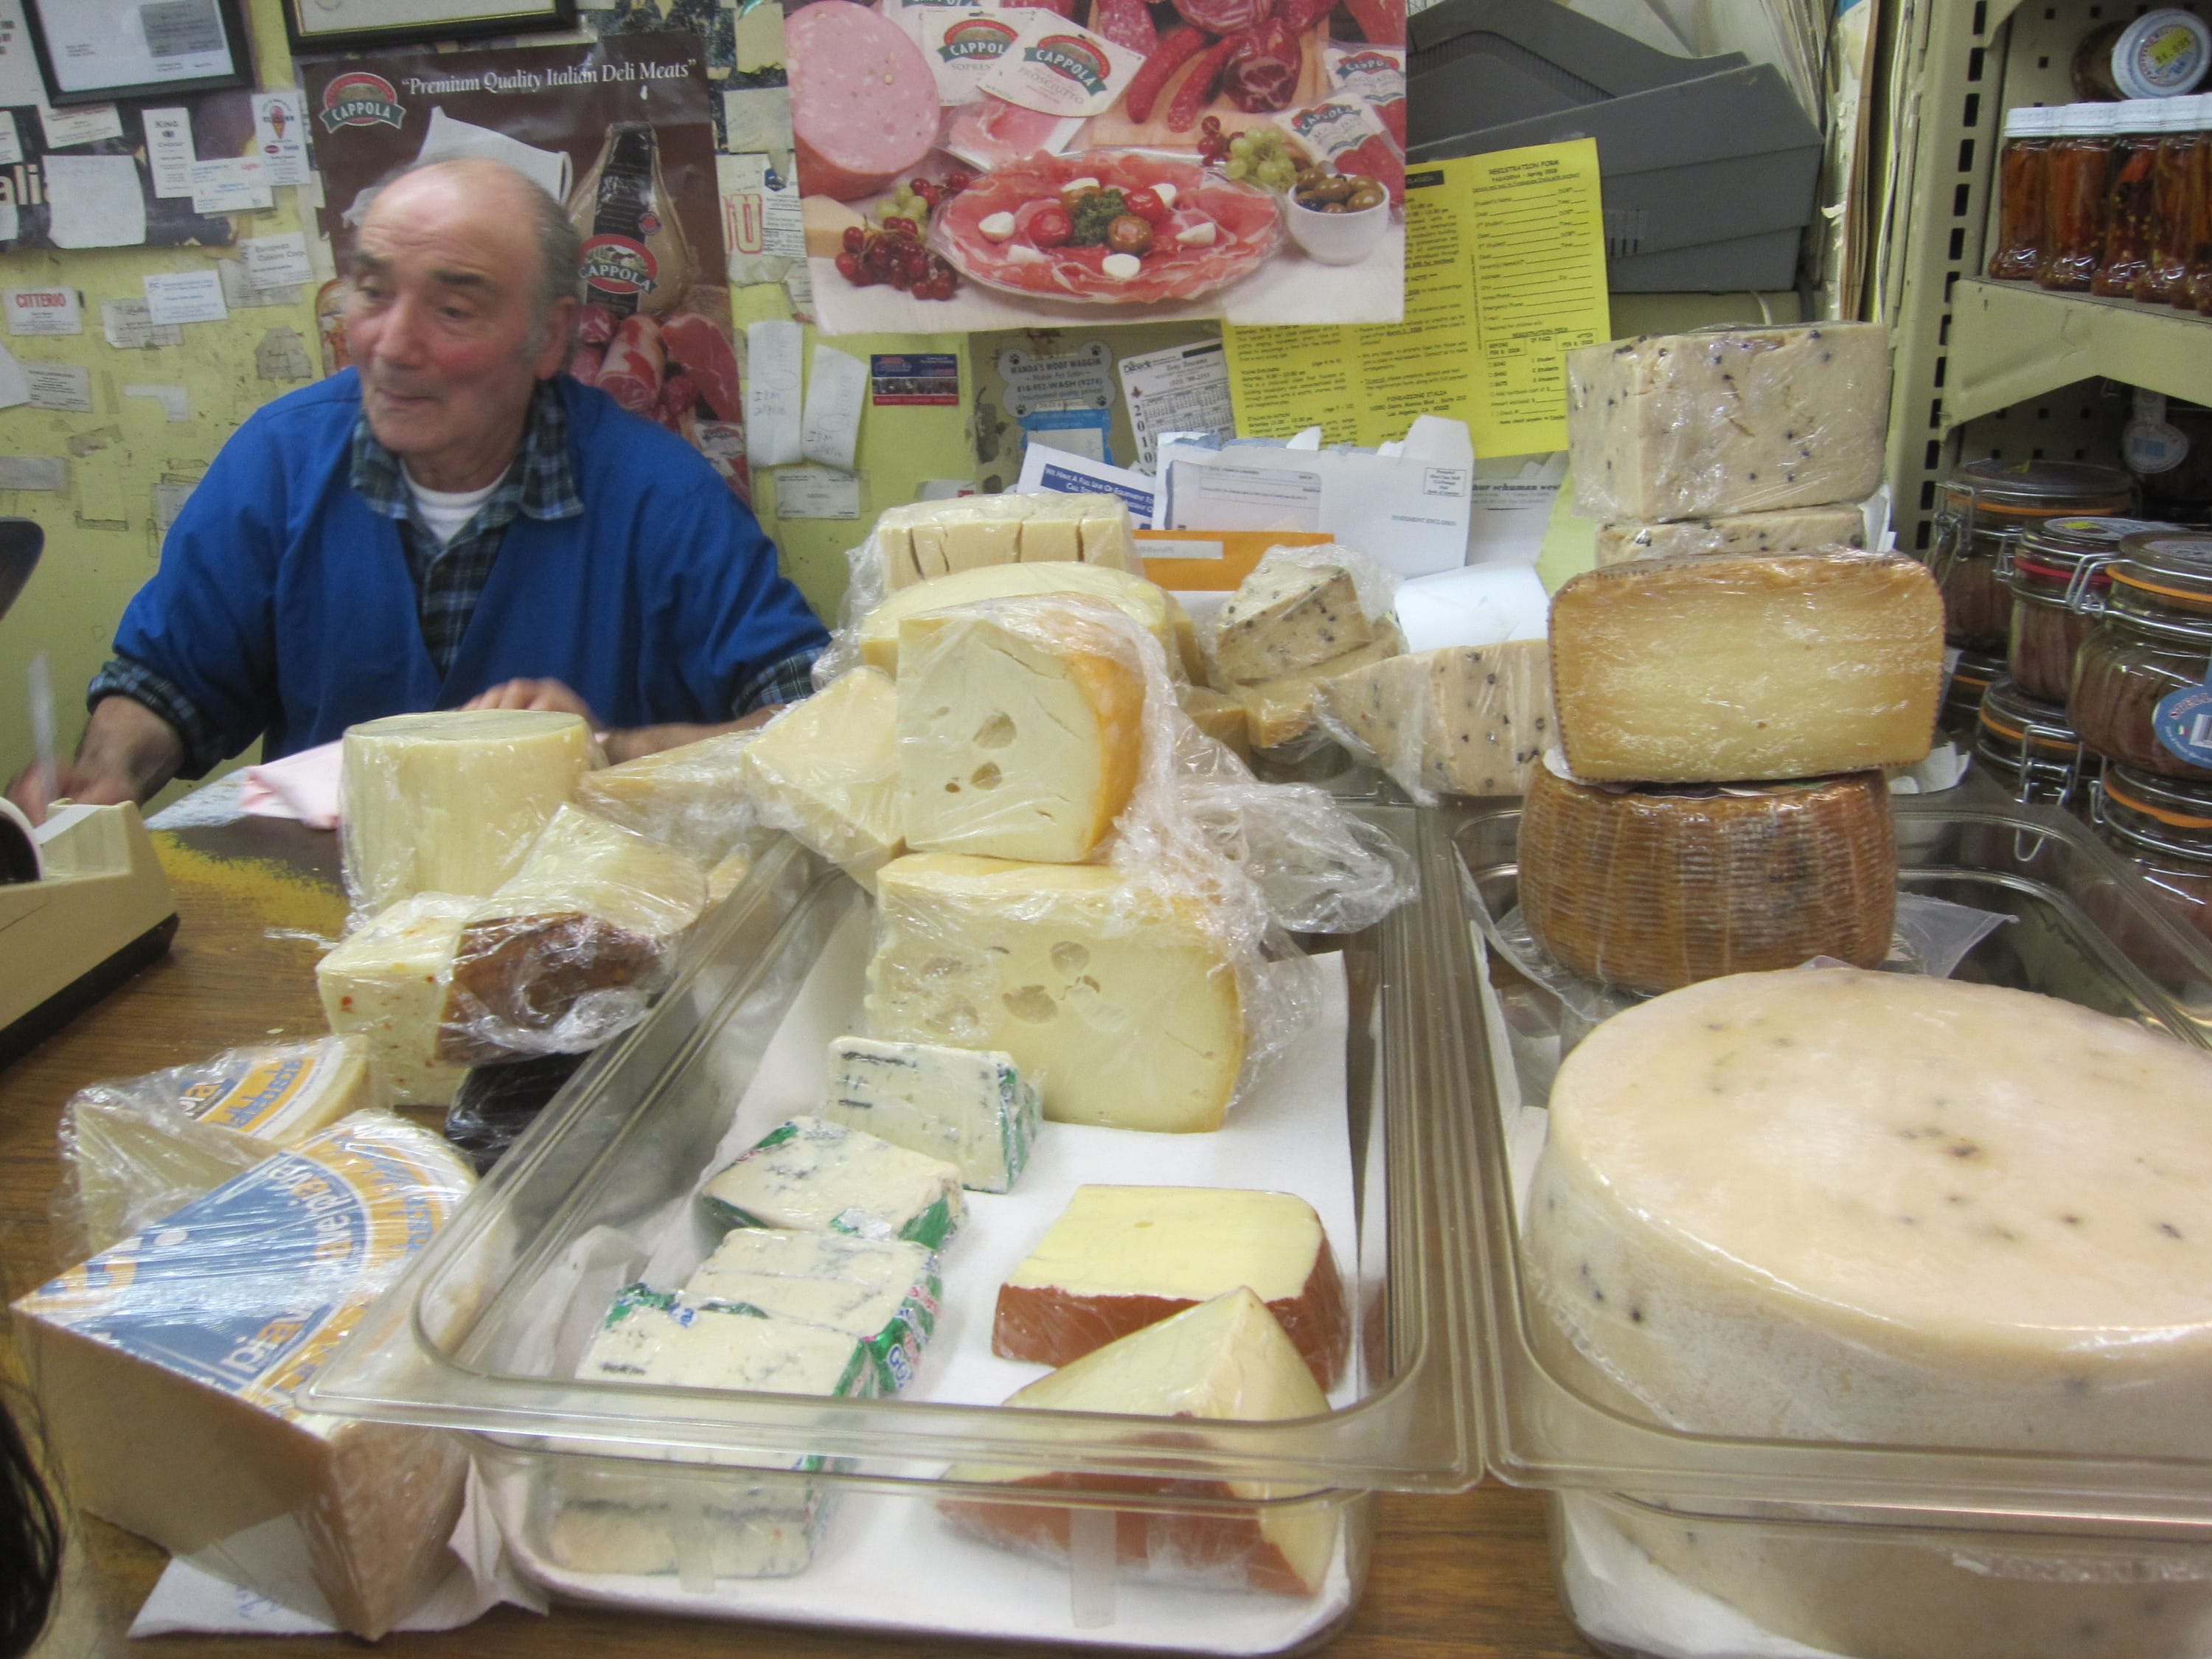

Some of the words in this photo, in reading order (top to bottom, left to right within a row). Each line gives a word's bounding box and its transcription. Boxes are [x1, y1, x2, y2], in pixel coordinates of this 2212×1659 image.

[950, 41, 1006, 56] CAPPOL
[484, 72, 541, 94] Quality
[546, 67, 597, 87] Italian
[602, 63, 635, 83] Deli
[1035, 49, 1097, 87] CAPPOLA
[333, 102, 392, 122] CAPPOLA
[579, 264, 652, 293] CAPPOLA
